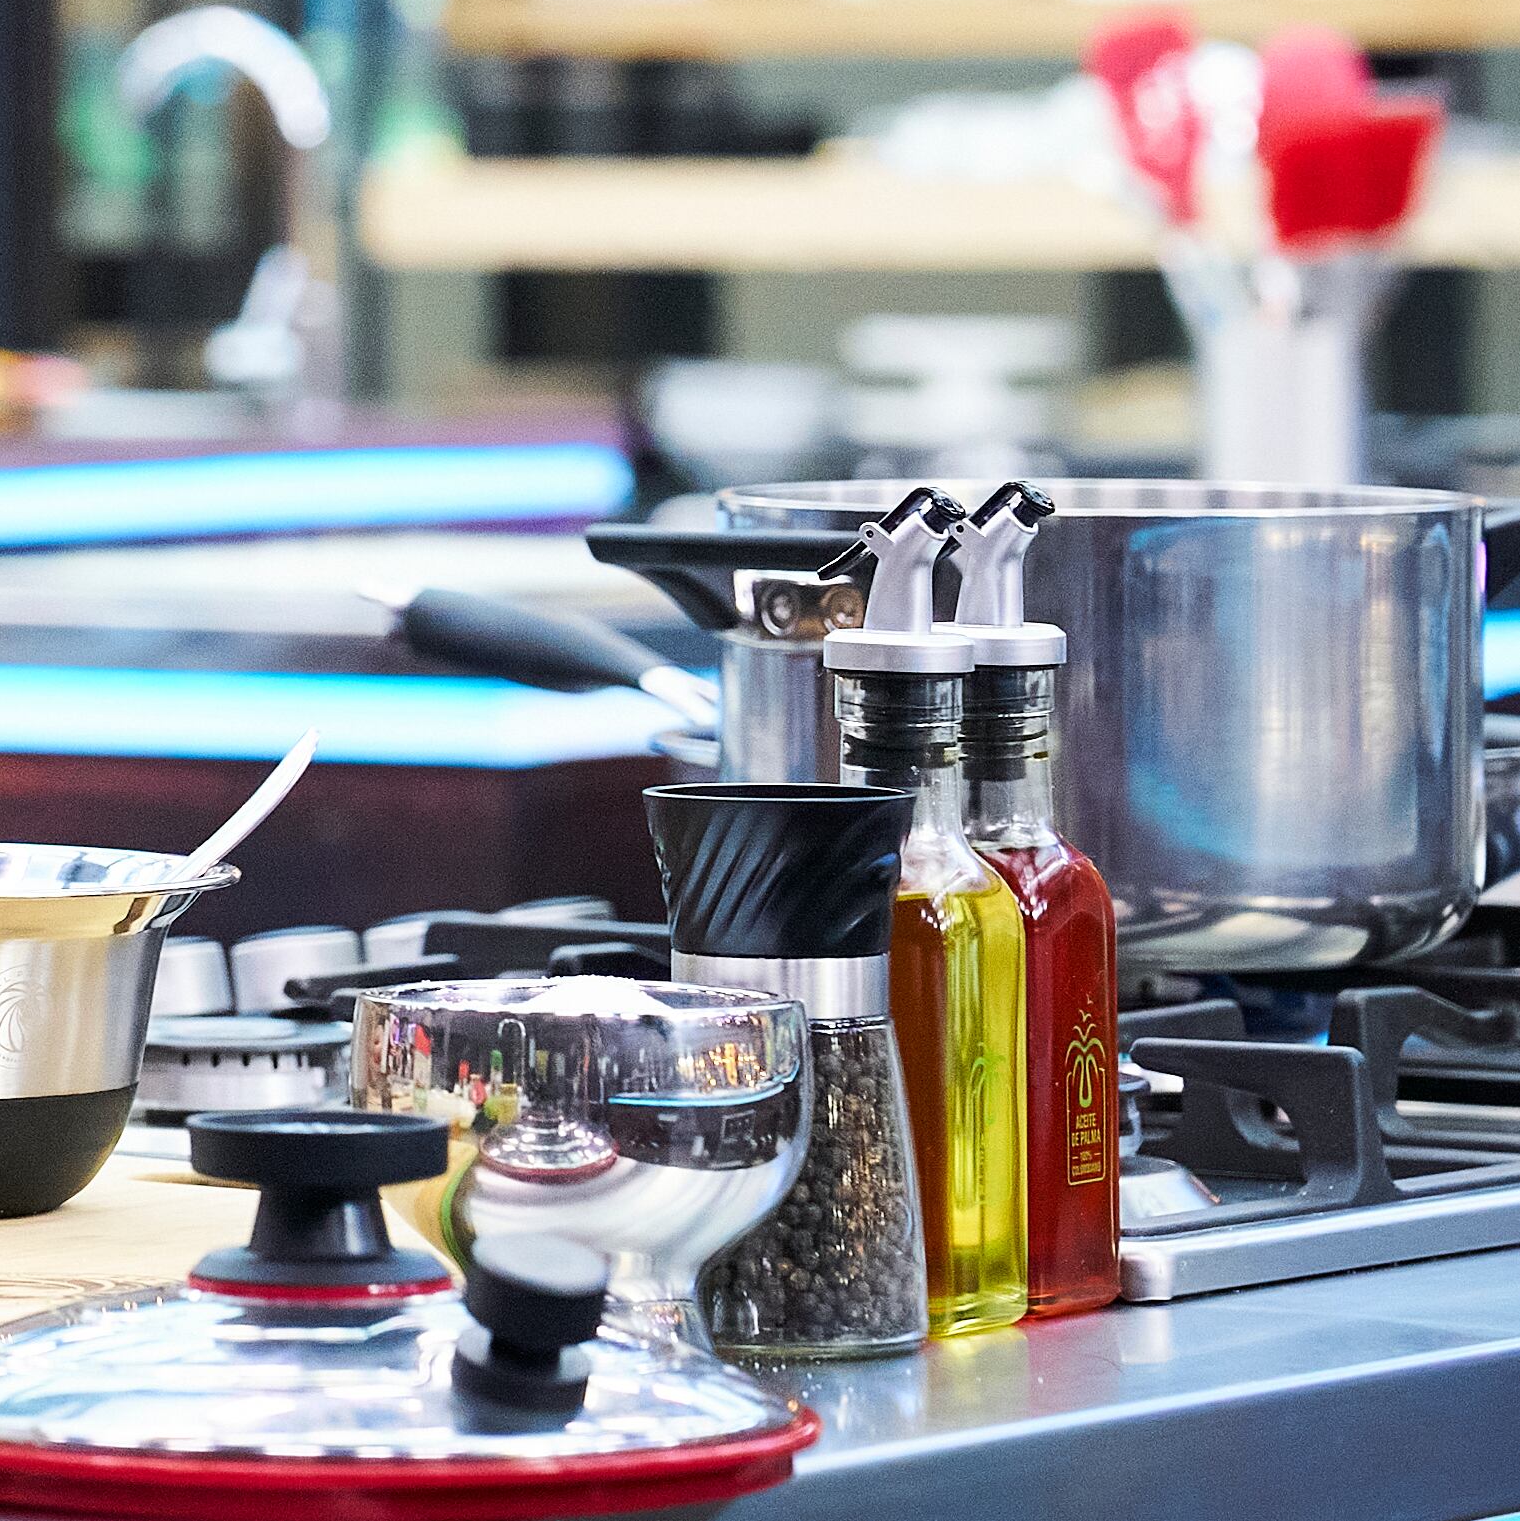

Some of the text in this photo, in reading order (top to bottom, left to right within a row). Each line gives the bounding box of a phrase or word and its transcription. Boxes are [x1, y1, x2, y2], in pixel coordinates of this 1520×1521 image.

[1075, 1112, 1097, 1130] ACEITE
[1071, 1128, 1101, 1147] DE PALMA
